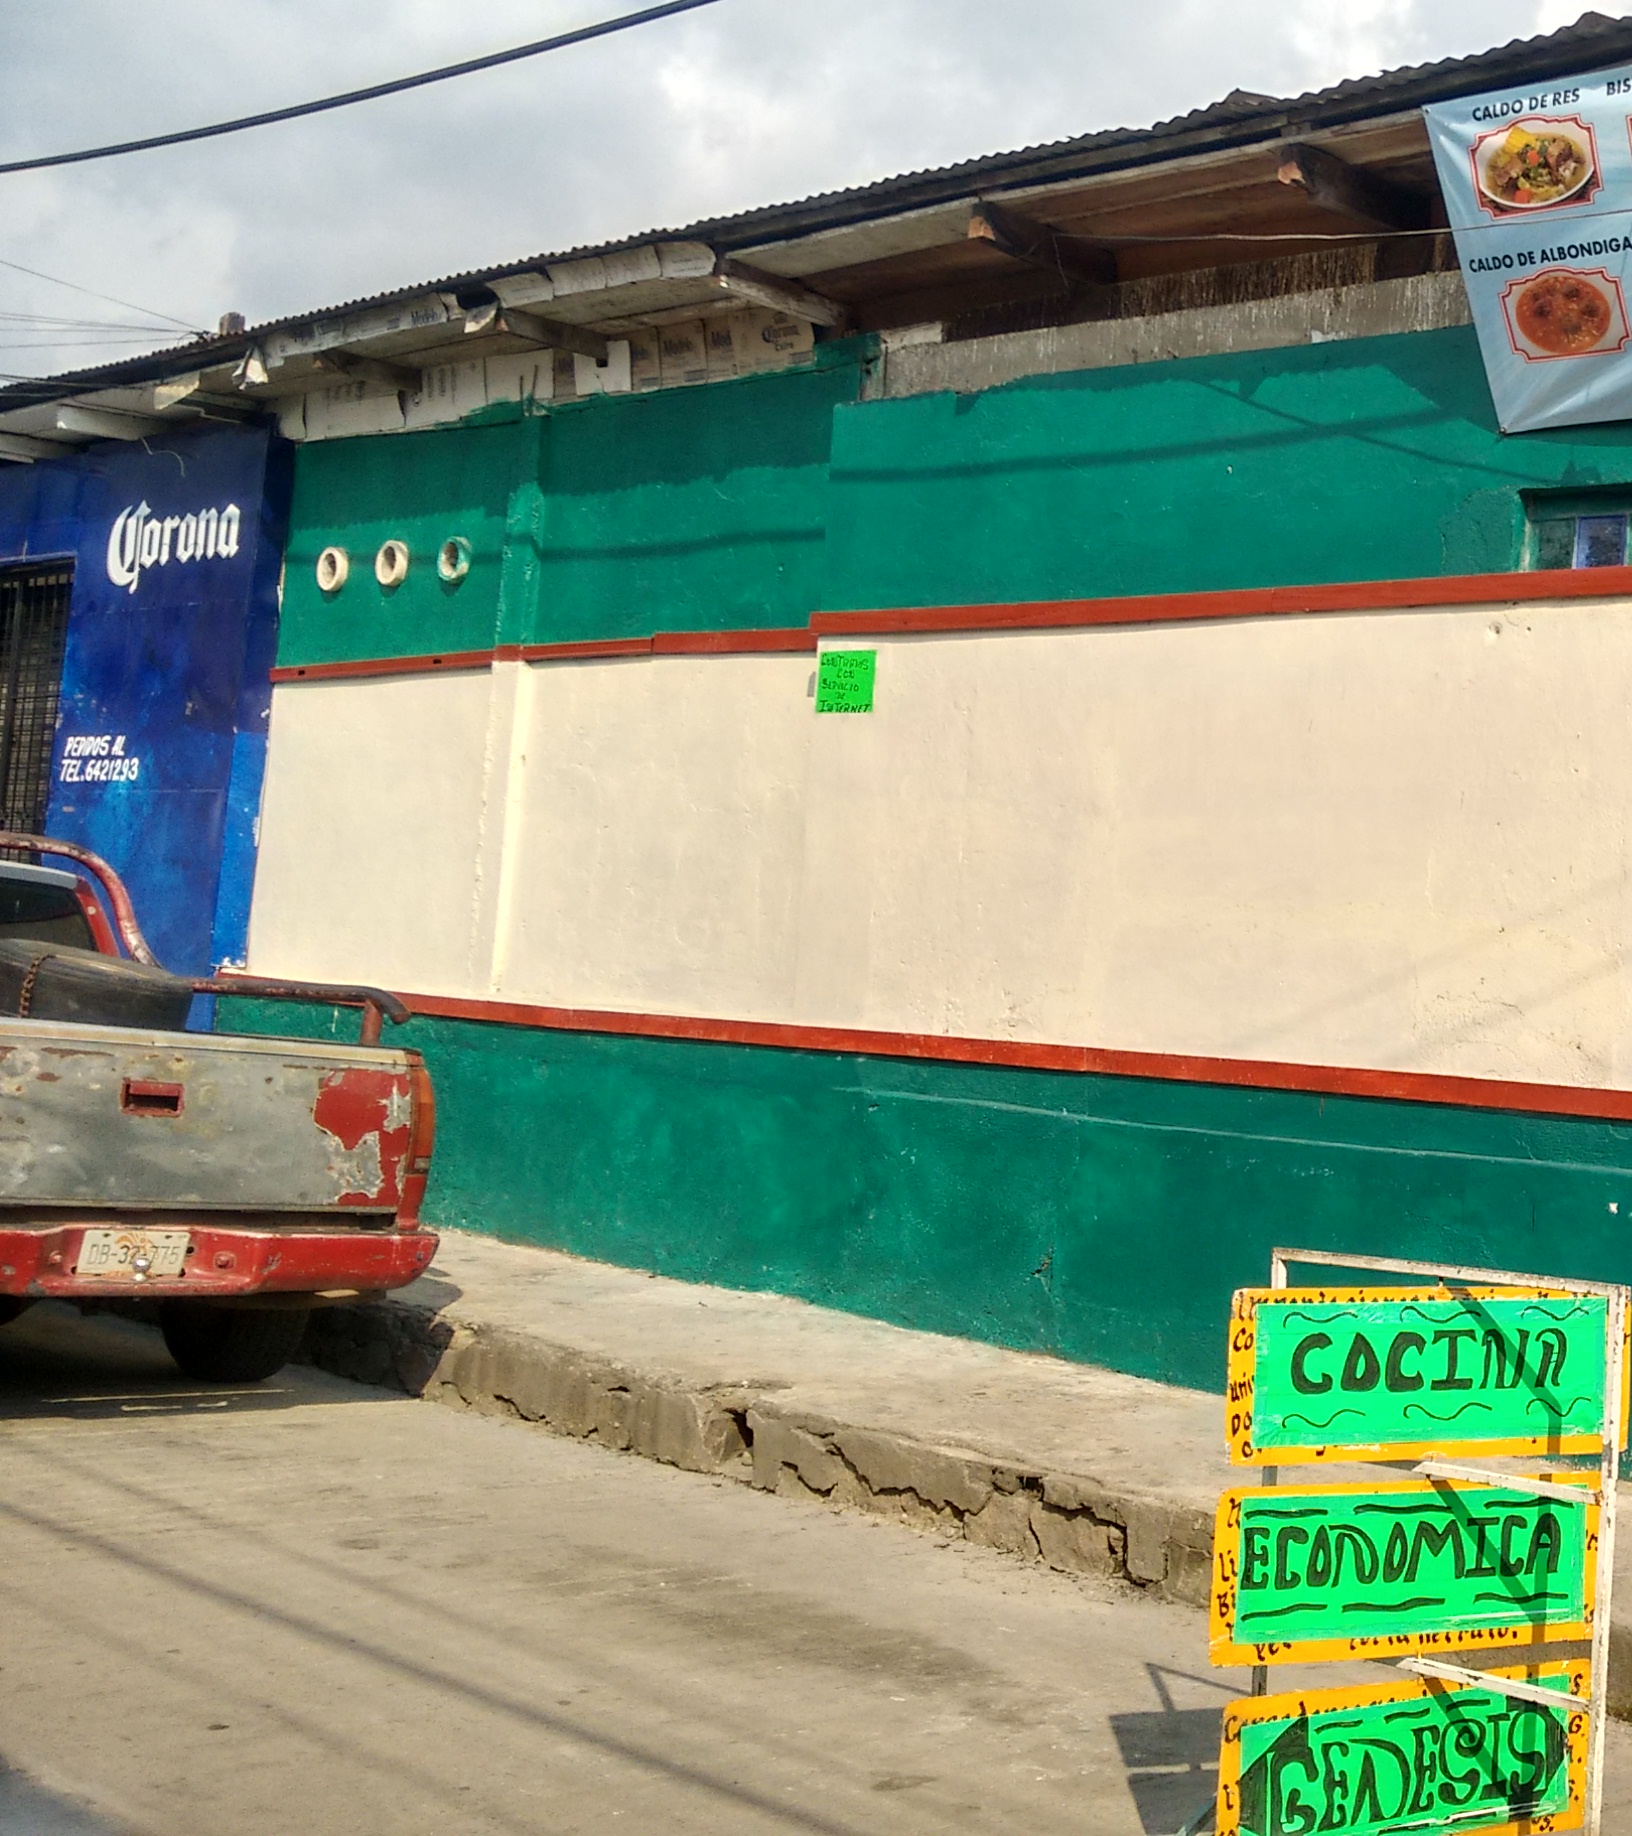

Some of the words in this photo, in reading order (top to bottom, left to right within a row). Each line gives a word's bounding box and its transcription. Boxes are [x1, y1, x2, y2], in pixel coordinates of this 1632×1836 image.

[1472, 99, 1524, 122] CALDO
[1529, 94, 1548, 110] DE
[1552, 88, 1581, 106] RES
[1469, 257, 1514, 274] CALDO
[1517, 251, 1537, 267] DE
[107, 500, 240, 594] Corona
[111, 735, 126, 756] AL
[1291, 1327, 1568, 1395] COCINA
[1239, 1512, 1561, 1591] ECONOMICA
[1269, 1707, 1547, 1834] GENESIS
